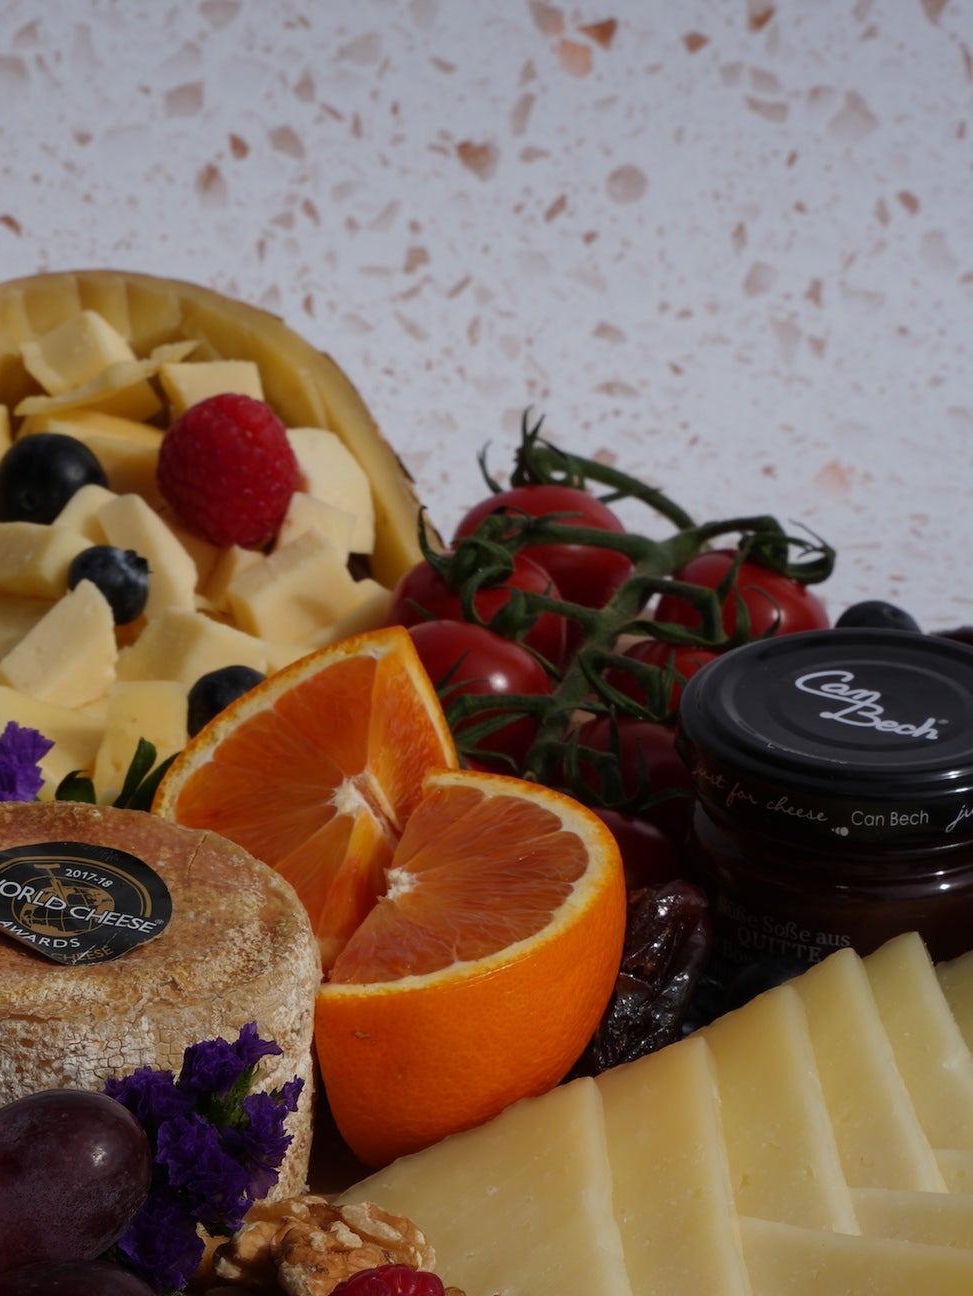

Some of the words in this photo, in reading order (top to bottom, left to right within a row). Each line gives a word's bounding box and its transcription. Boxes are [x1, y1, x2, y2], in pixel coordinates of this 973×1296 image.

[794, 669, 882, 706] Can
[725, 782, 760, 809] for
[766, 796, 829, 823] cheese
[850, 809, 885, 828] Can
[889, 809, 930, 828] Bech
[64, 867, 115, 890] 2017-18
[69, 905, 157, 935] CHEESE
[815, 931, 852, 948] aus
